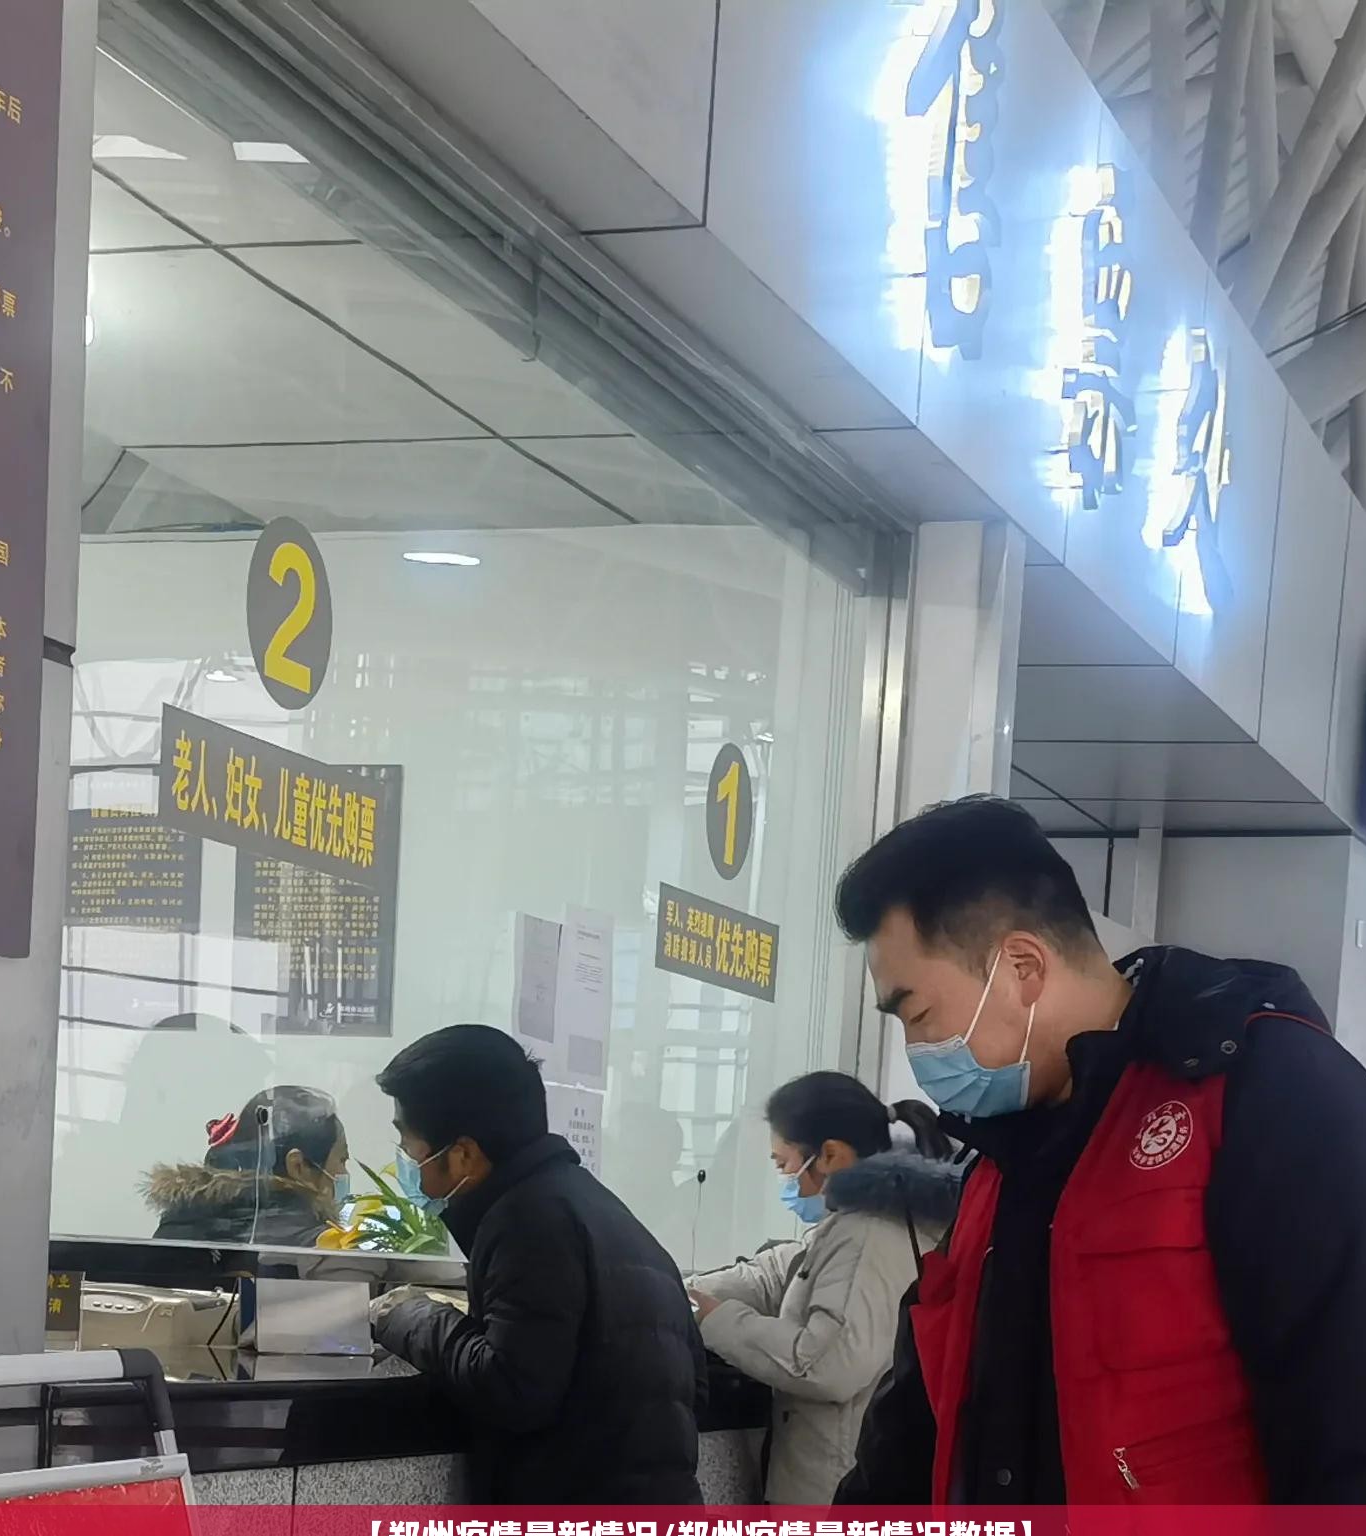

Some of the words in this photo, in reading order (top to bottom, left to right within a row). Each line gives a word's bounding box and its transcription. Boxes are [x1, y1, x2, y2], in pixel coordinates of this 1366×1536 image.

[264, 542, 316, 694] 2
[172, 730, 378, 868] 老人、妇女、儿童优先购票
[718, 761, 740, 866] 1
[715, 917, 773, 988] 优先购票
